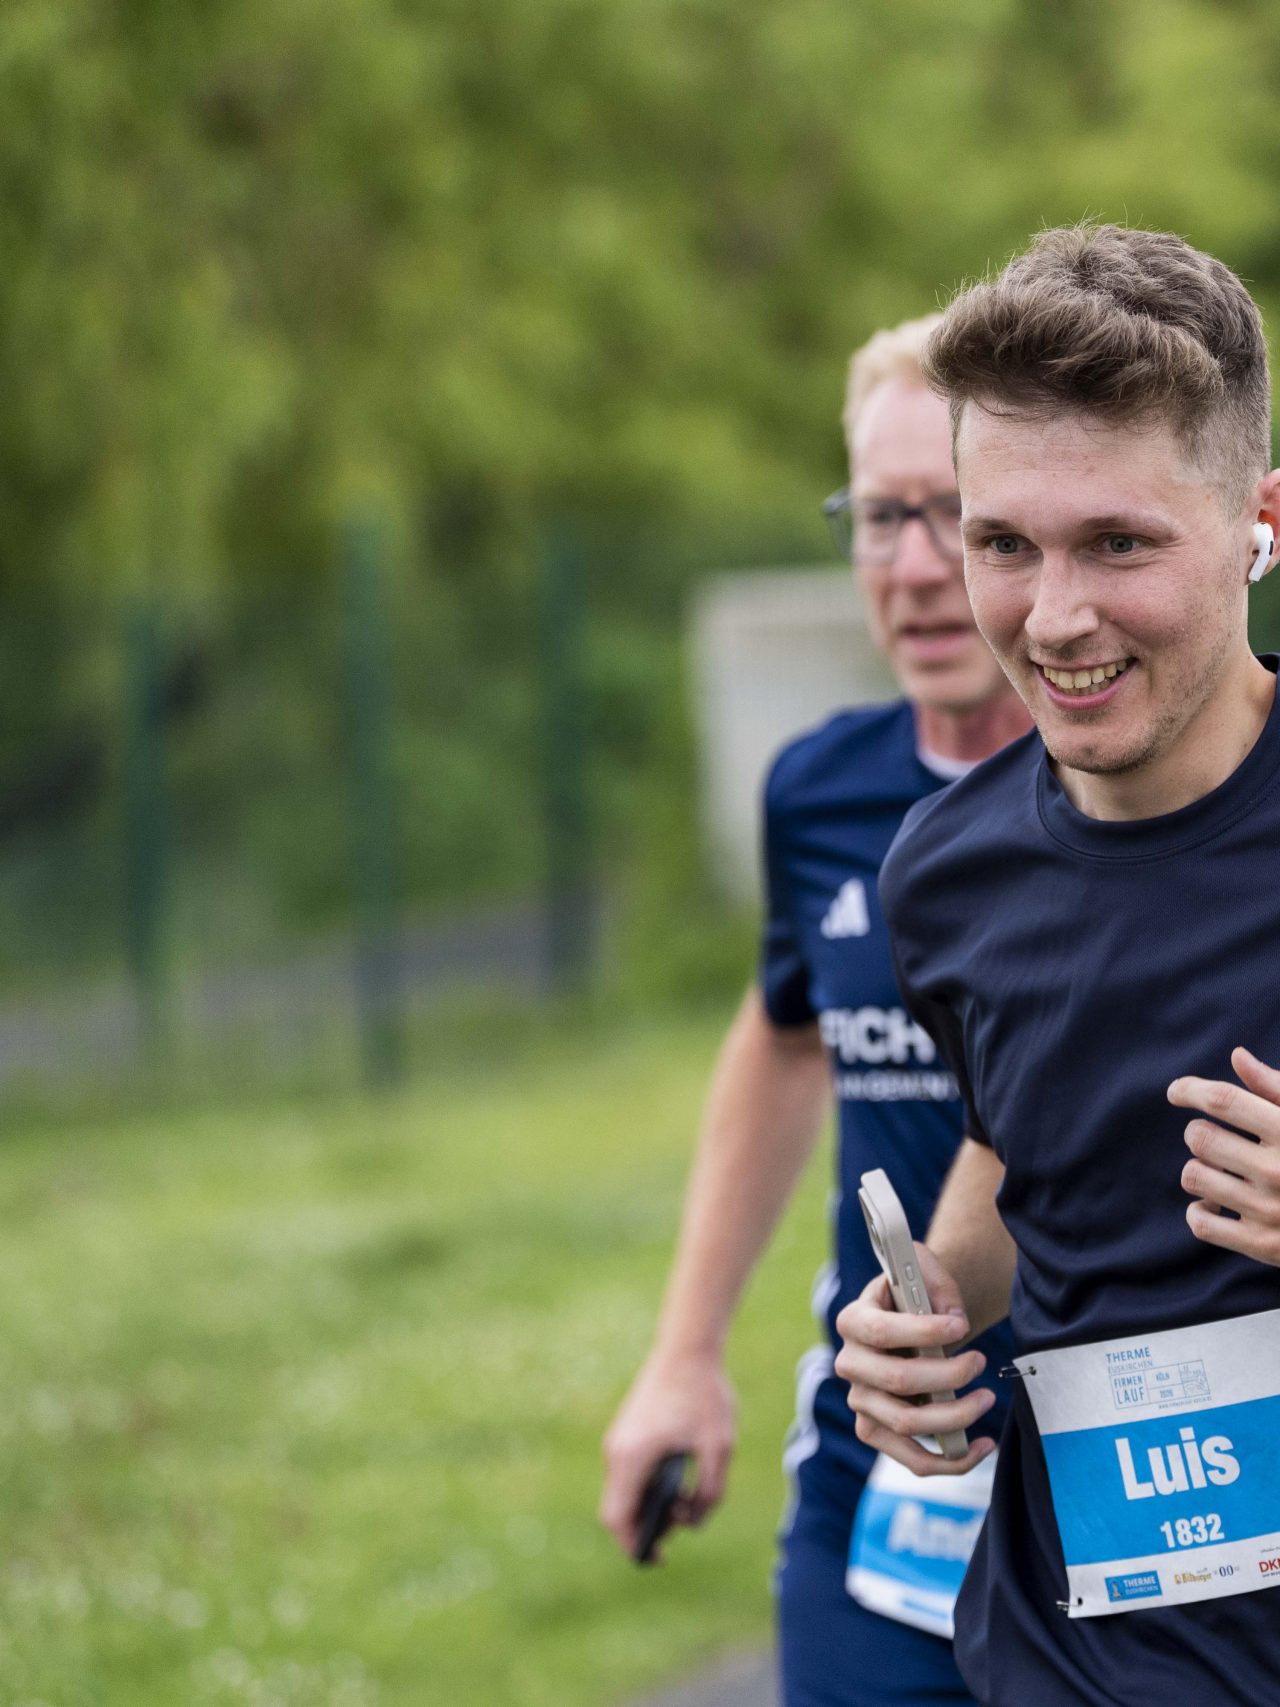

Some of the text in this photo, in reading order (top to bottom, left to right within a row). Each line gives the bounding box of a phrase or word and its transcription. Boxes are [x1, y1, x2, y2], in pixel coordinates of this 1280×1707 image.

[1105, 1347, 1152, 1364] THERME
[1107, 1360, 1154, 1374] EUSKIRCHEN
[1113, 1375, 1143, 1389] FIRMEN
[1116, 1387, 1145, 1405] LAUF
[1114, 1426, 1241, 1501] Luis
[1160, 1513, 1226, 1549] 1832
[1123, 1575, 1157, 1588] THERME
